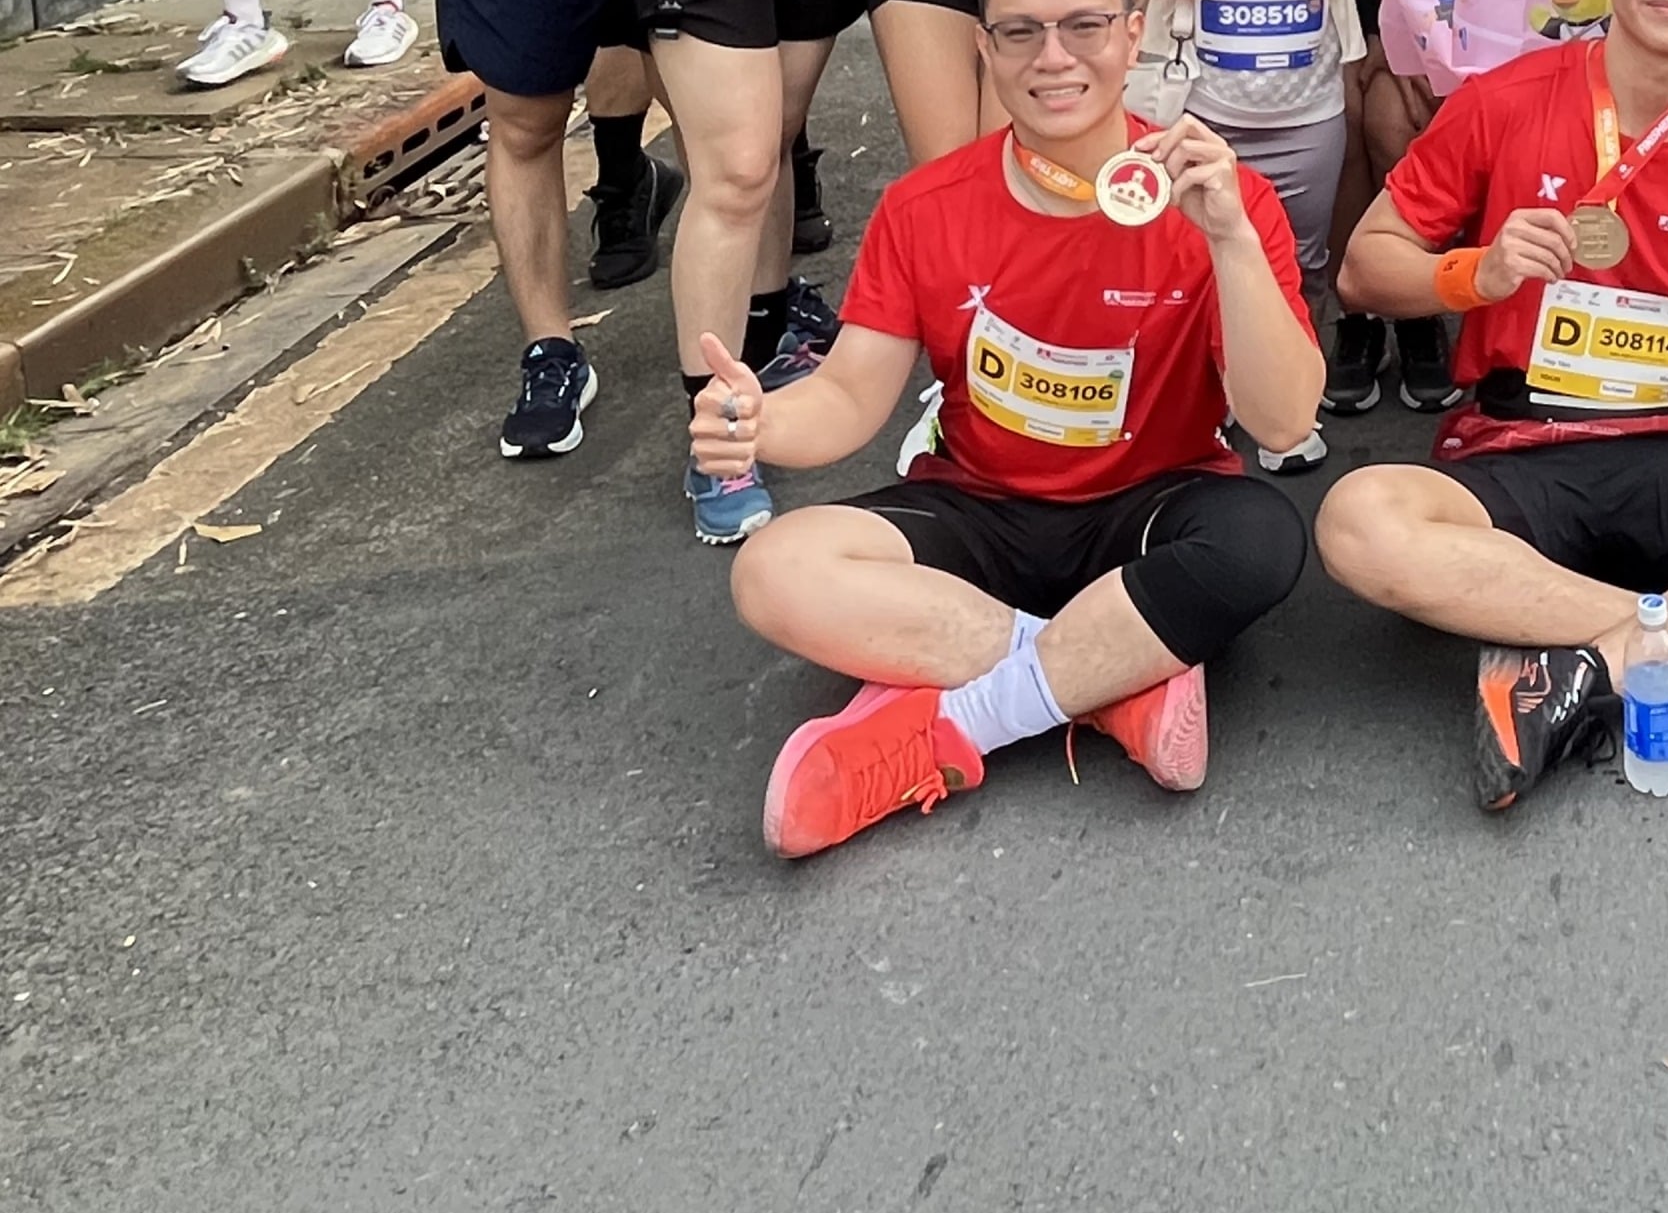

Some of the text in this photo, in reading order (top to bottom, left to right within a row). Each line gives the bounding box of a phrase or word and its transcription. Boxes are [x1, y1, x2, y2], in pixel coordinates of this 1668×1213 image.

[1218, 2, 1309, 26] 308516
[1550, 315, 1582, 347] D
[979, 347, 1005, 380] D
[1019, 371, 1114, 411] 308106
